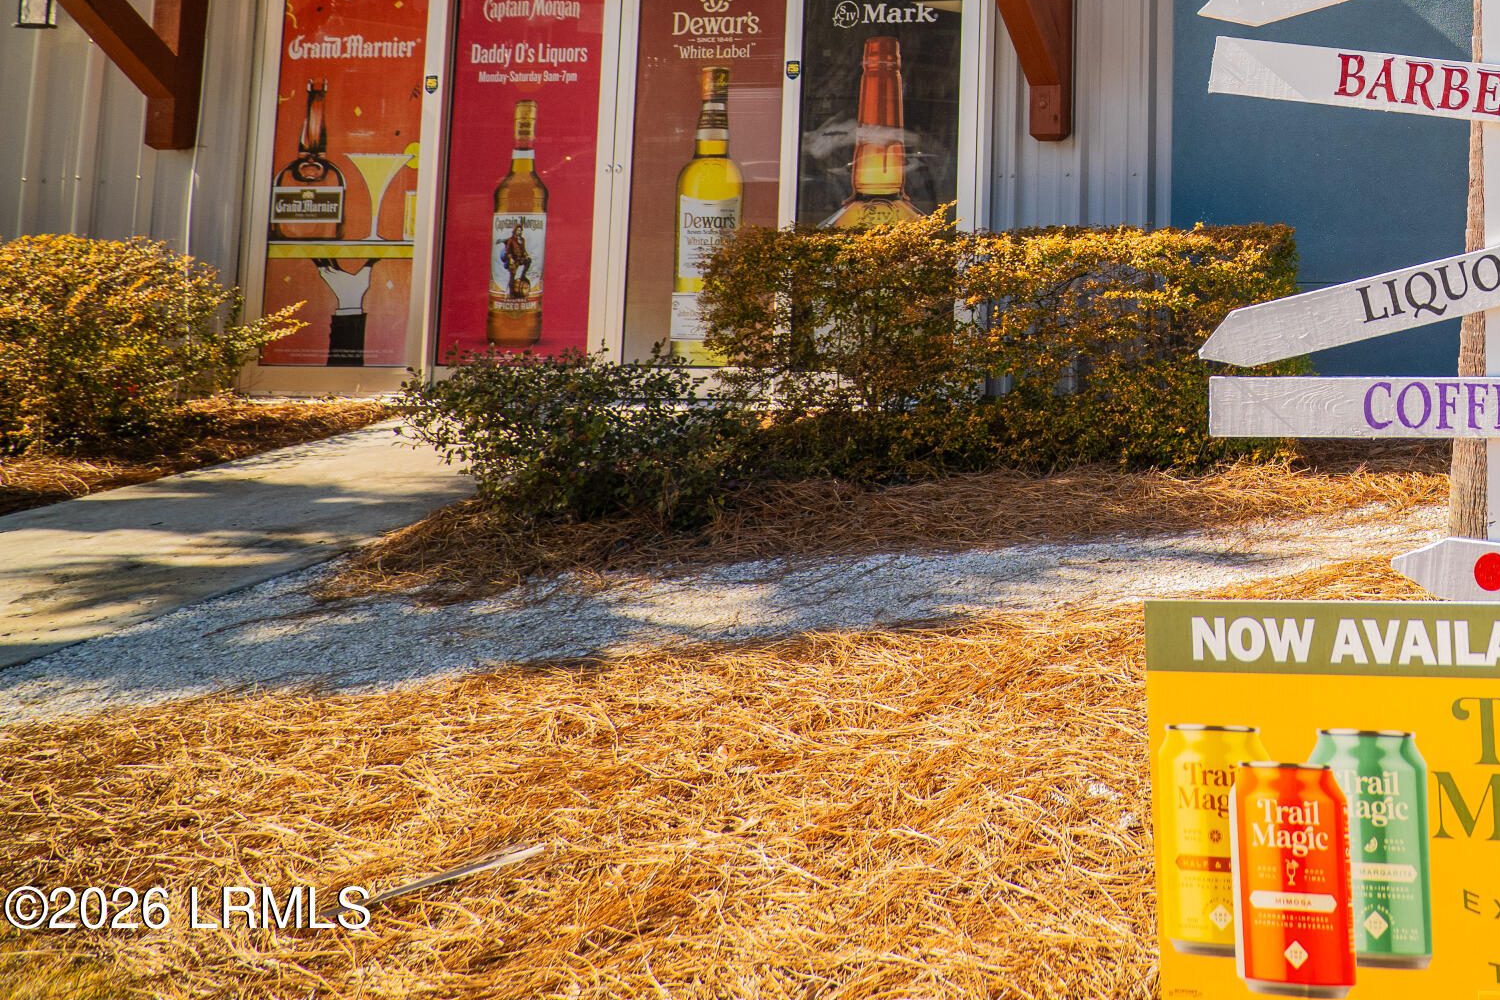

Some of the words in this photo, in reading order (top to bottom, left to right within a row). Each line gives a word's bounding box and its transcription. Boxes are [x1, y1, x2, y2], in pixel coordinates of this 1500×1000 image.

[672, 11, 760, 36] Dewar's
[861, 2, 937, 24] Mark
[288, 34, 342, 60] Grand
[341, 34, 417, 59] Marnier
[471, 43, 513, 69] Daddy
[515, 42, 536, 64] O's
[538, 42, 588, 67] Liquors
[478, 70, 542, 85] Monday-Saturday
[543, 70, 578, 84] 9am-7pm
[275, 199, 302, 214] Grand
[301, 199, 339, 213] Marnier
[684, 212, 737, 230] Dewar's
[494, 302, 519, 311] SPICED
[521, 301, 537, 310] RUM
[1190, 615, 1316, 664] NOW
[1182, 762, 1237, 788] Trai
[1177, 786, 1231, 819] Mag
[1257, 798, 1320, 826] Trail
[1349, 795, 1410, 828] agic
[1251, 822, 1329, 858] Magic
[1275, 897, 1313, 907] MIMOSA
